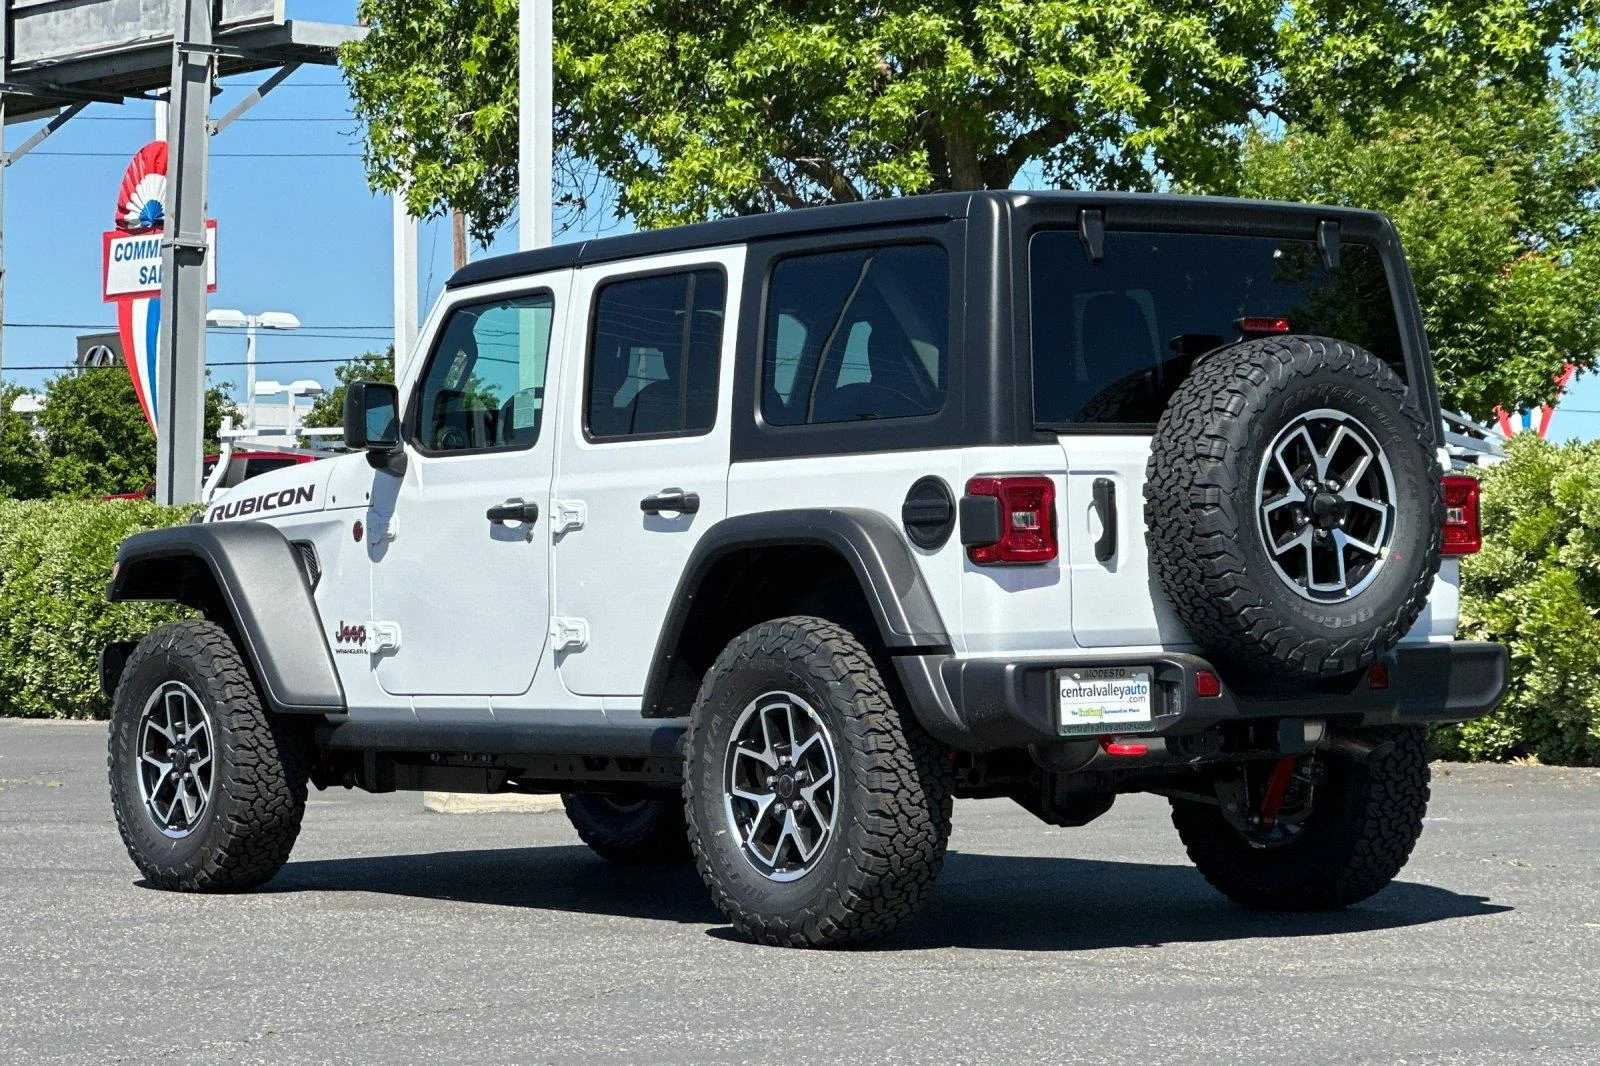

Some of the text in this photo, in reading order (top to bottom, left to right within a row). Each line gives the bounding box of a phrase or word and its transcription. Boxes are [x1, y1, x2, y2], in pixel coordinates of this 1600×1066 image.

[209, 484, 315, 522] RUBICON
[335, 620, 366, 647] Jeep
[1084, 668, 1126, 679] MODESTO
[1061, 683, 1147, 699] centralvalleyauto
[1063, 722, 1151, 734] centralvalleyauto.com
